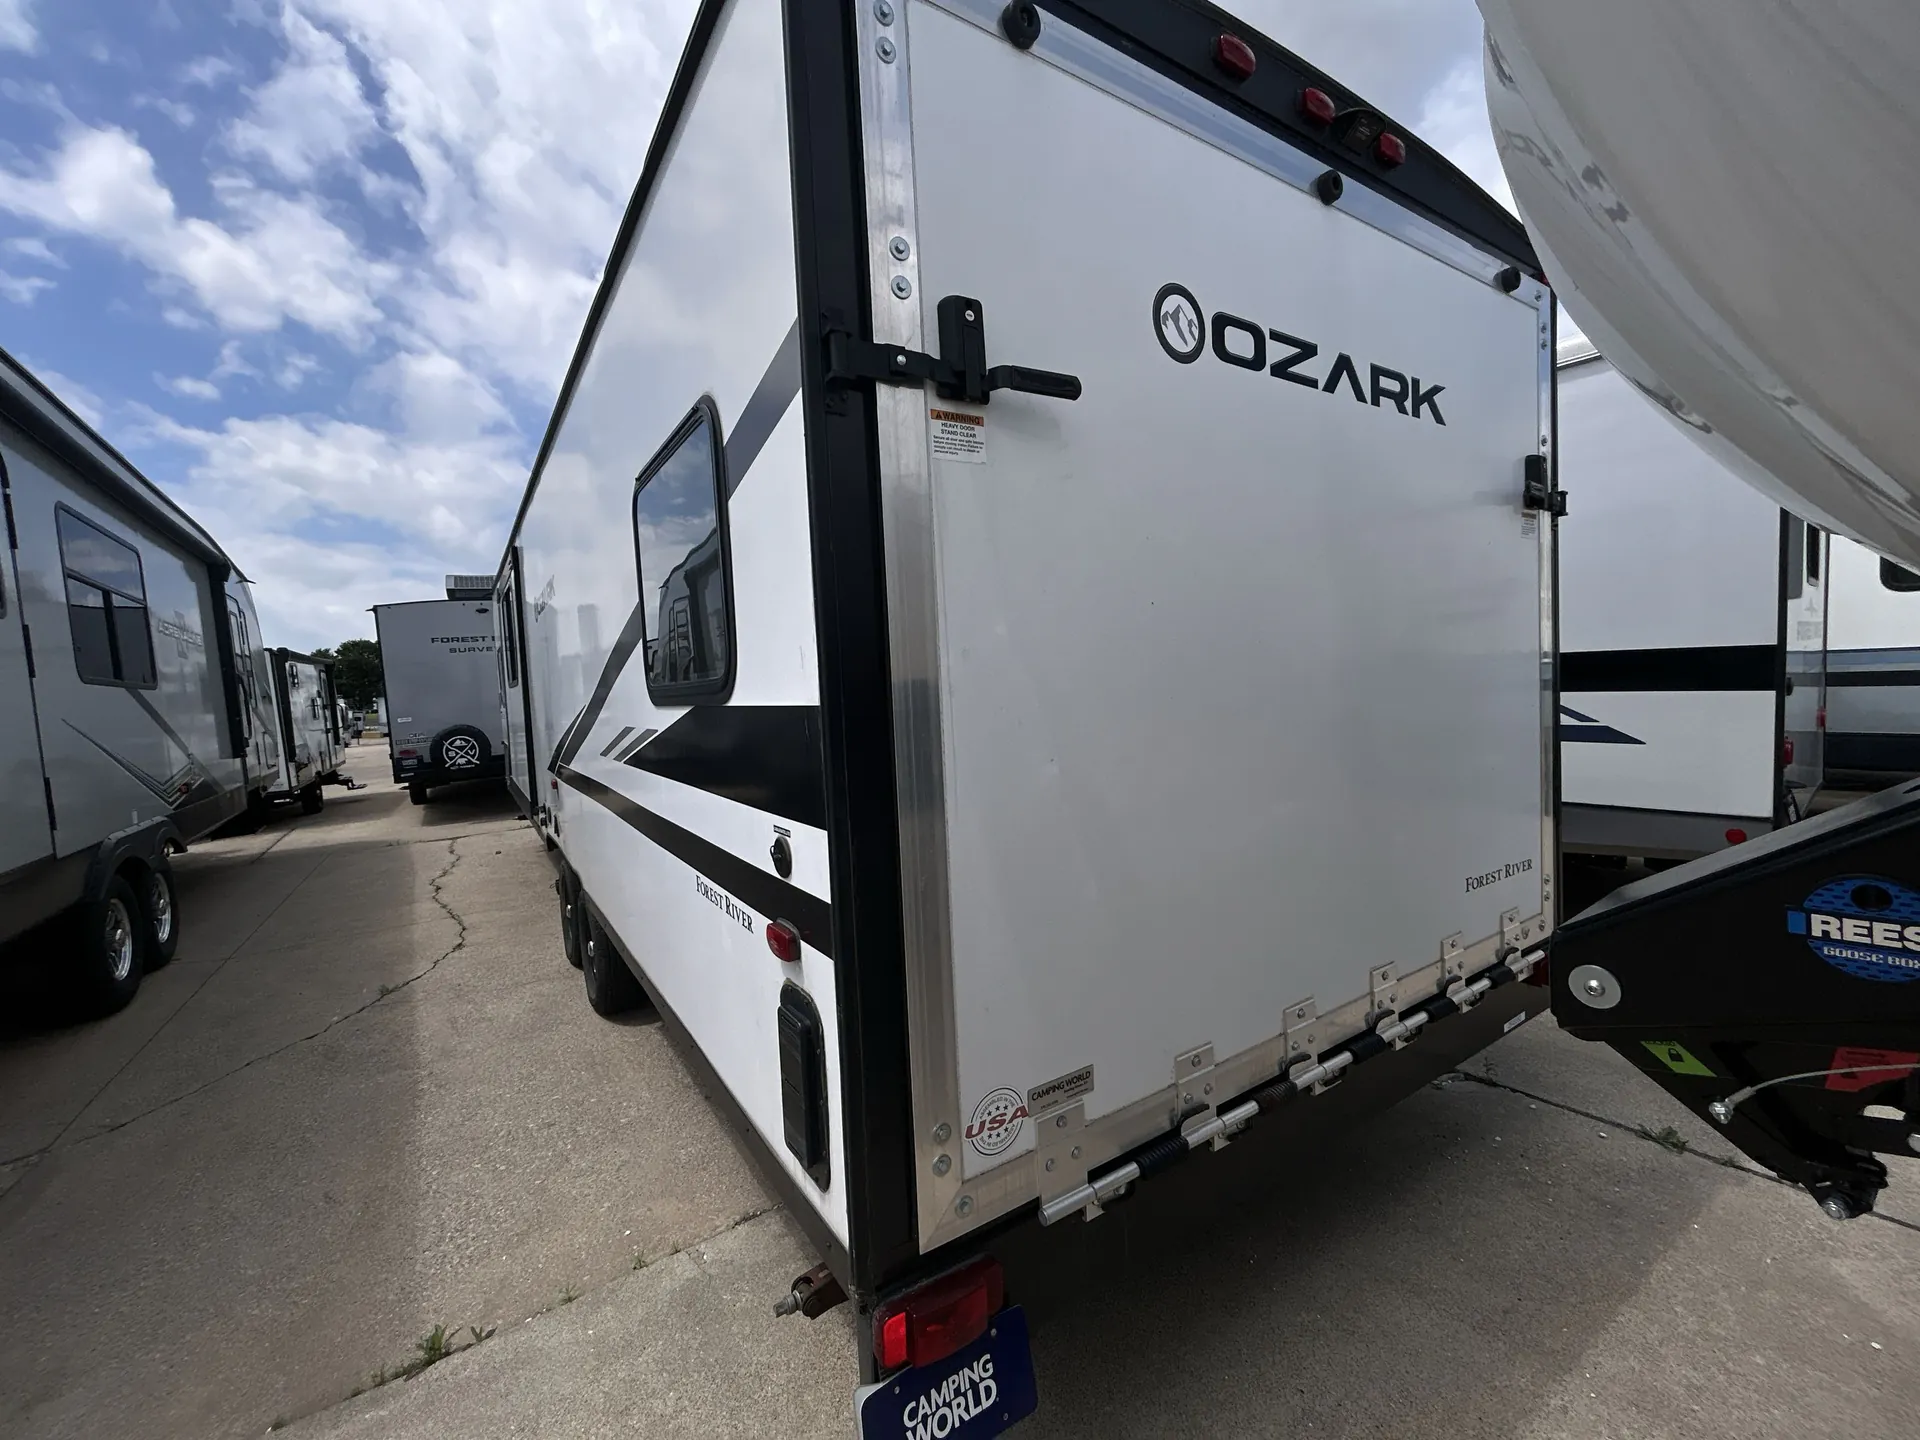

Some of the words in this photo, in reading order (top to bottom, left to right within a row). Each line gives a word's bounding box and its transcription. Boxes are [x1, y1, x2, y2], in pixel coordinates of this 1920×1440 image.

[1211, 311, 1447, 426] OZARK
[941, 422, 959, 430] HEAVY
[942, 411, 980, 425] WARNING
[430, 635, 488, 643] FOREST
[1823, 946, 1884, 963] GOOSE
[1031, 1081, 1065, 1101] CAMPING
[1065, 1071, 1091, 1087] WORLD
[965, 1105, 1029, 1139] USA
[903, 1353, 994, 1428] CAMPING
[905, 1378, 998, 1440] WORLD
